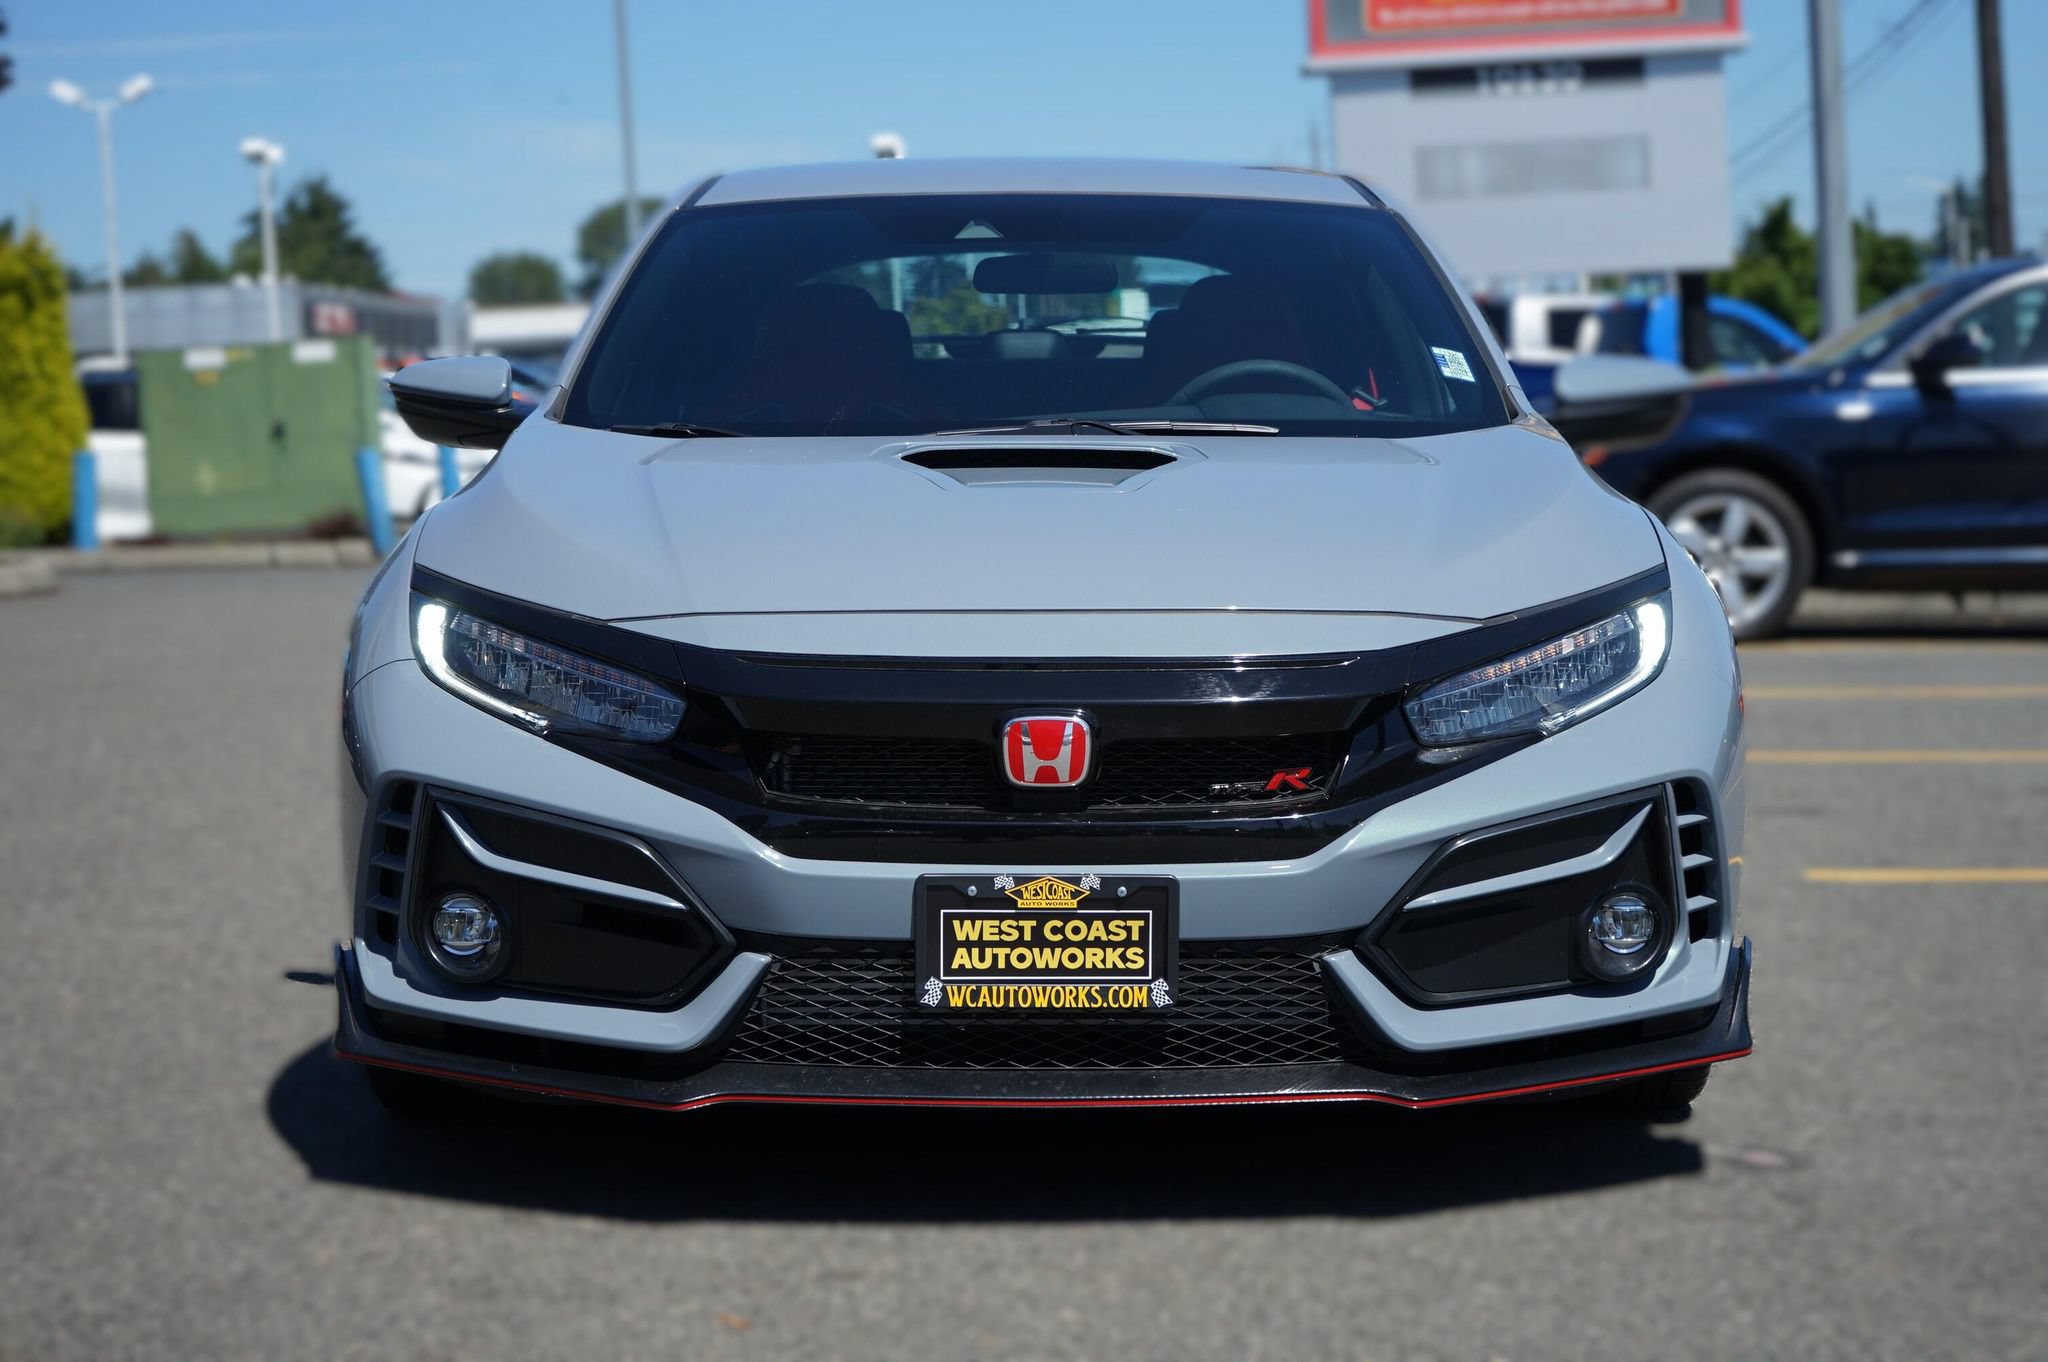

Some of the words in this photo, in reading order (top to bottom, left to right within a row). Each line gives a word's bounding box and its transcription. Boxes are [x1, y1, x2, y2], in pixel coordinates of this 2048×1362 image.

[1264, 767, 1312, 791] R
[952, 920, 1036, 941] WEST
[1043, 920, 1144, 941] COAST
[951, 947, 1145, 969] AUTOWORKS
[946, 986, 1148, 1008] WCAUTOWORKS.COM
